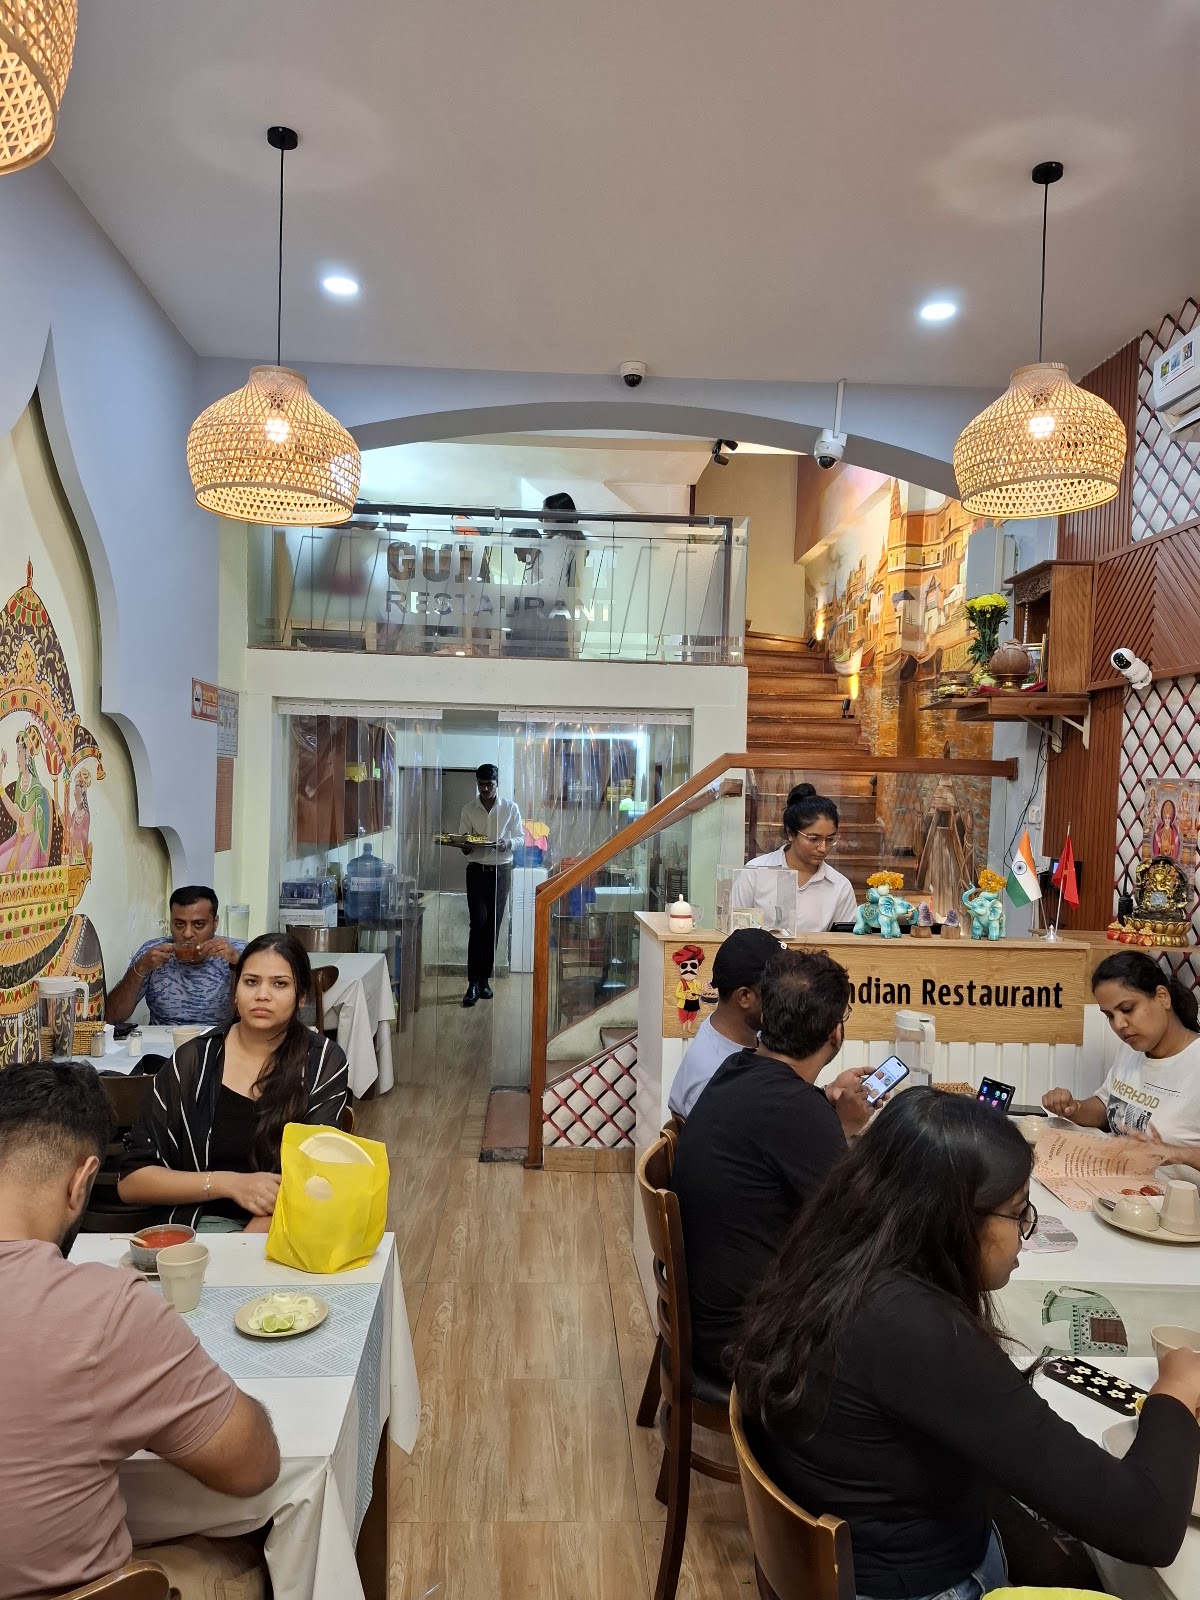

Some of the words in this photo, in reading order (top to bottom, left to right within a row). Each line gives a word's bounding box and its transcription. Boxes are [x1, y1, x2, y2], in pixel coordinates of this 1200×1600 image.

[385, 590, 616, 622] RESTAURANT
[849, 976, 911, 1005] ndian
[922, 978, 1063, 1009] Restaurant
